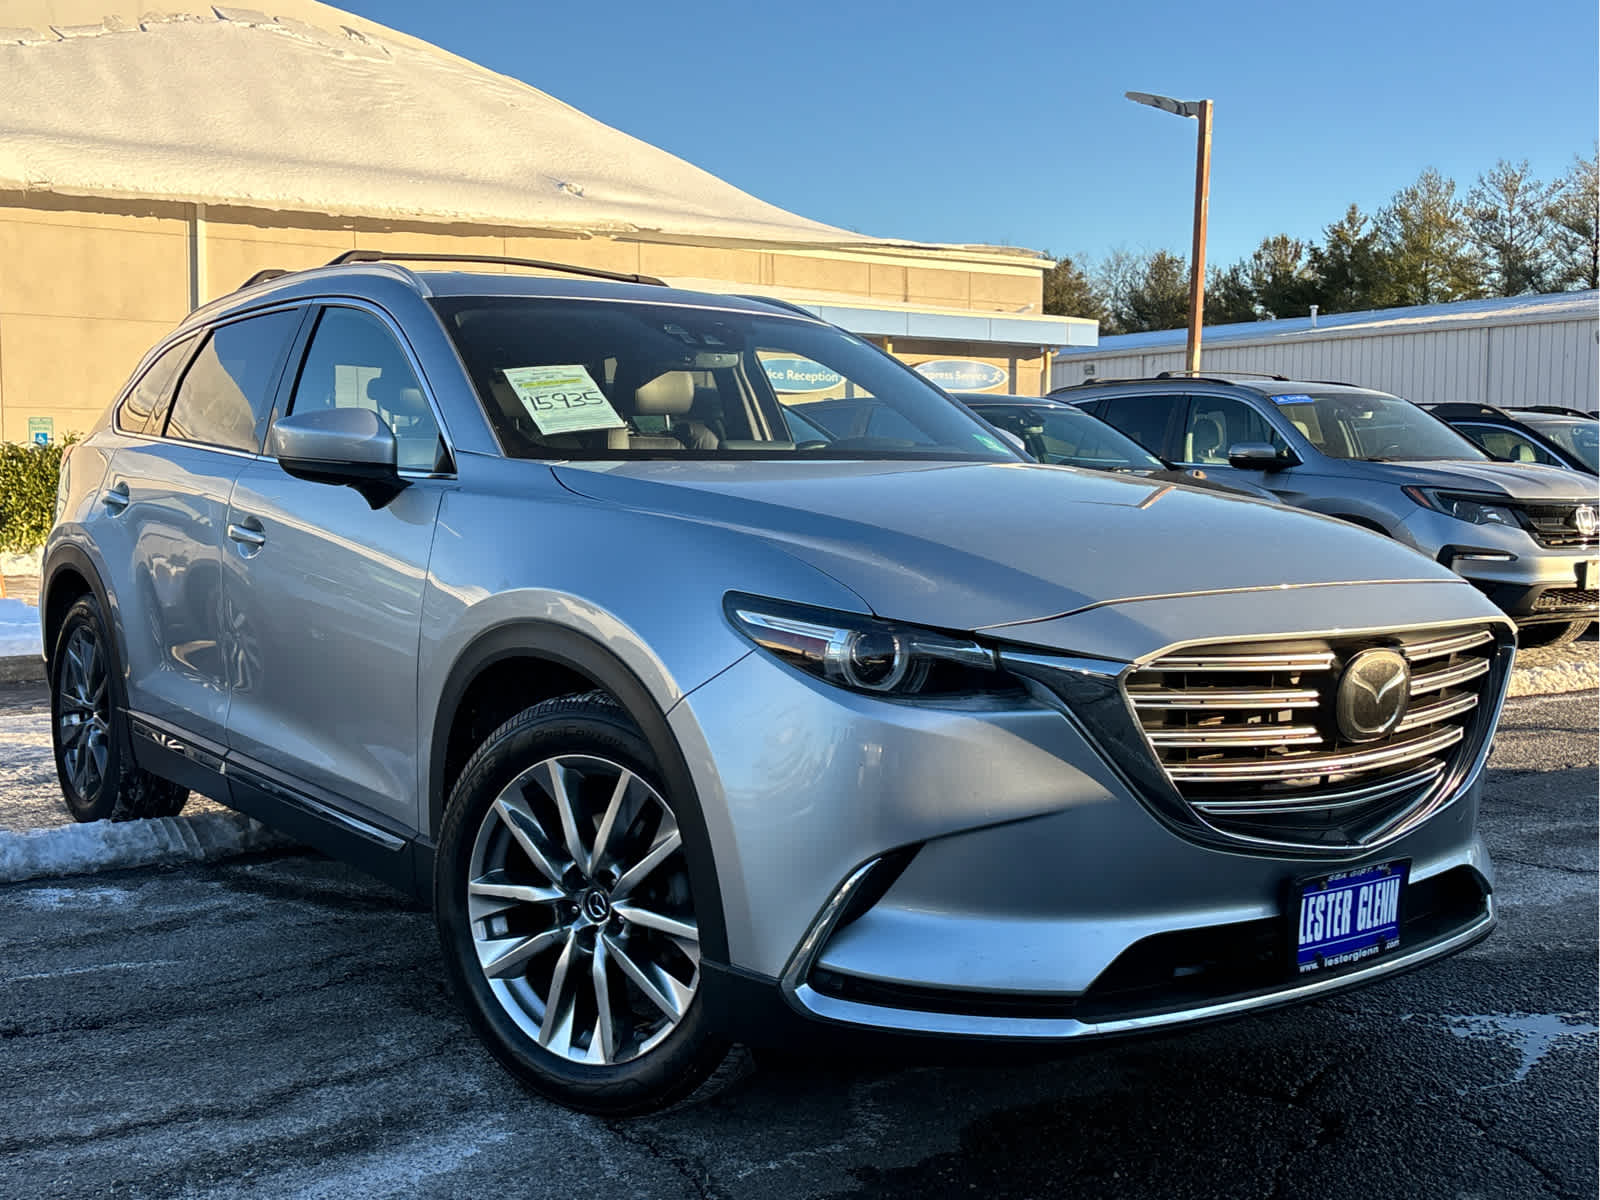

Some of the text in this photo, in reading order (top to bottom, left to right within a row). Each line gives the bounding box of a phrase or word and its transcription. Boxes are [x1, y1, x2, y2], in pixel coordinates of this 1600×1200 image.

[786, 369, 838, 385] Reception
[955, 370, 989, 382] Service
[1299, 878, 1400, 945] LESTER GLENN
